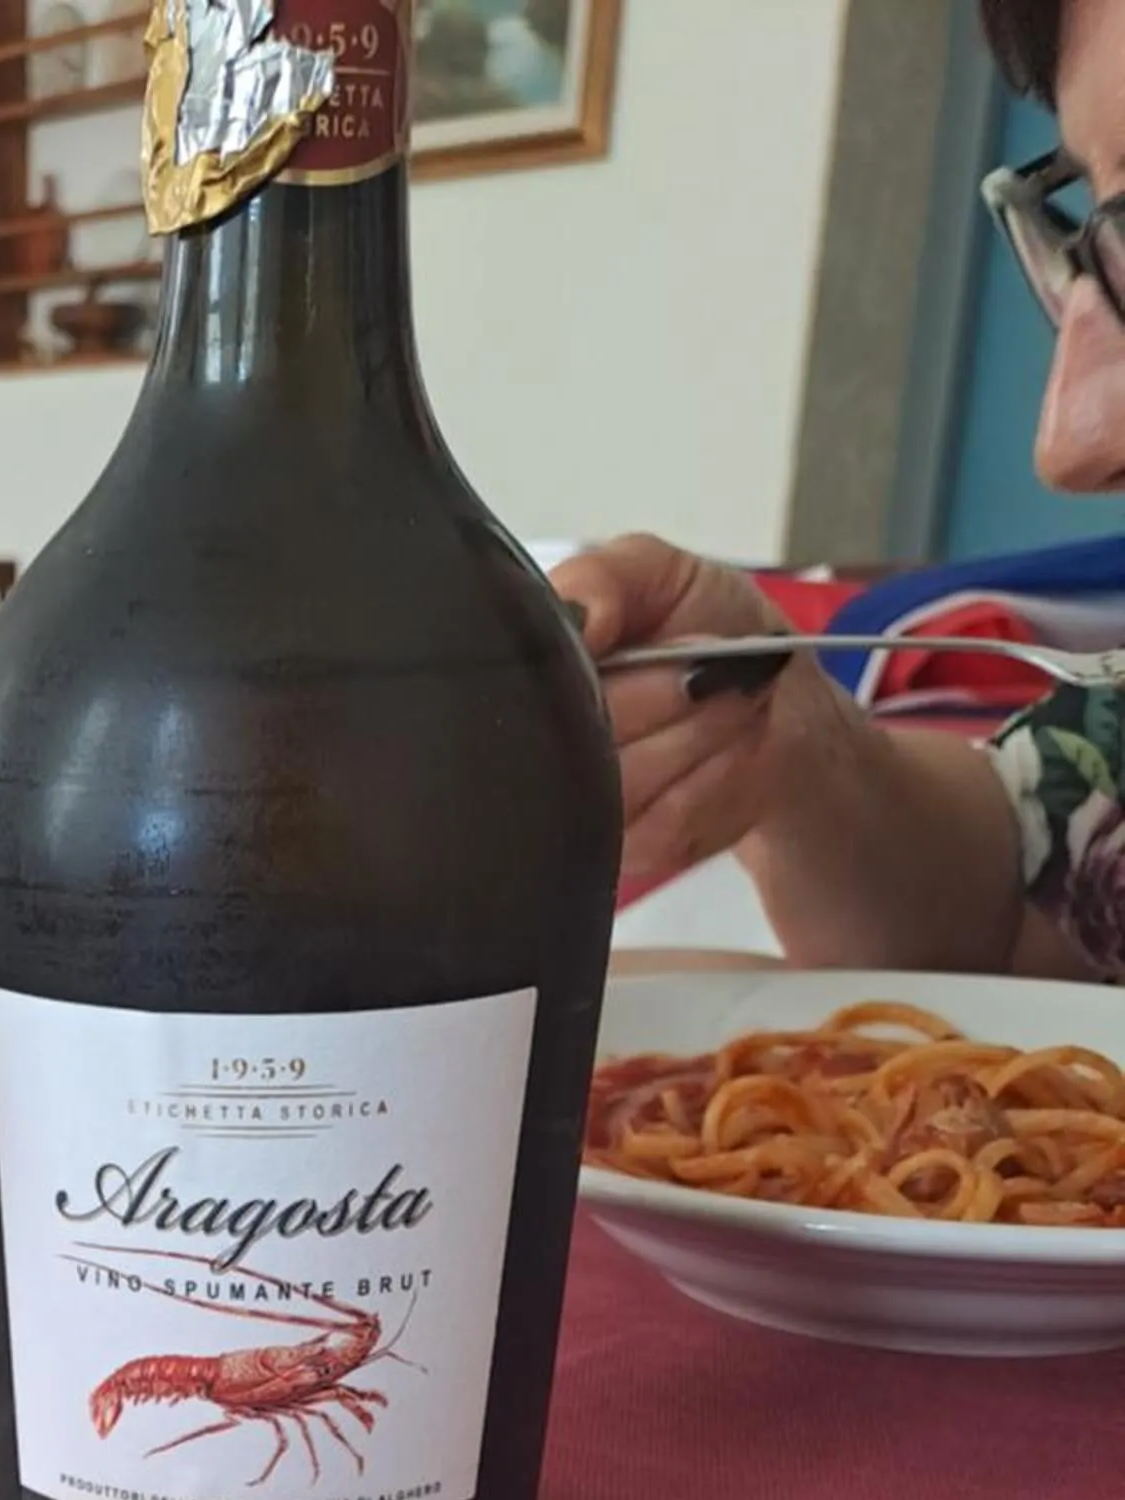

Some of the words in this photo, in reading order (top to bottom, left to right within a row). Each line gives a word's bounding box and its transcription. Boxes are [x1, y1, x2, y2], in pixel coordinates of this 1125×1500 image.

[127, 1098, 263, 1121] ETICHETTA
[280, 1100, 388, 1121] STORICA
[55, 1146, 434, 1273] Aragosta
[76, 1264, 143, 1292] VINO
[164, 1281, 335, 1301] SPUMANTE
[357, 1269, 433, 1297] BRUT
